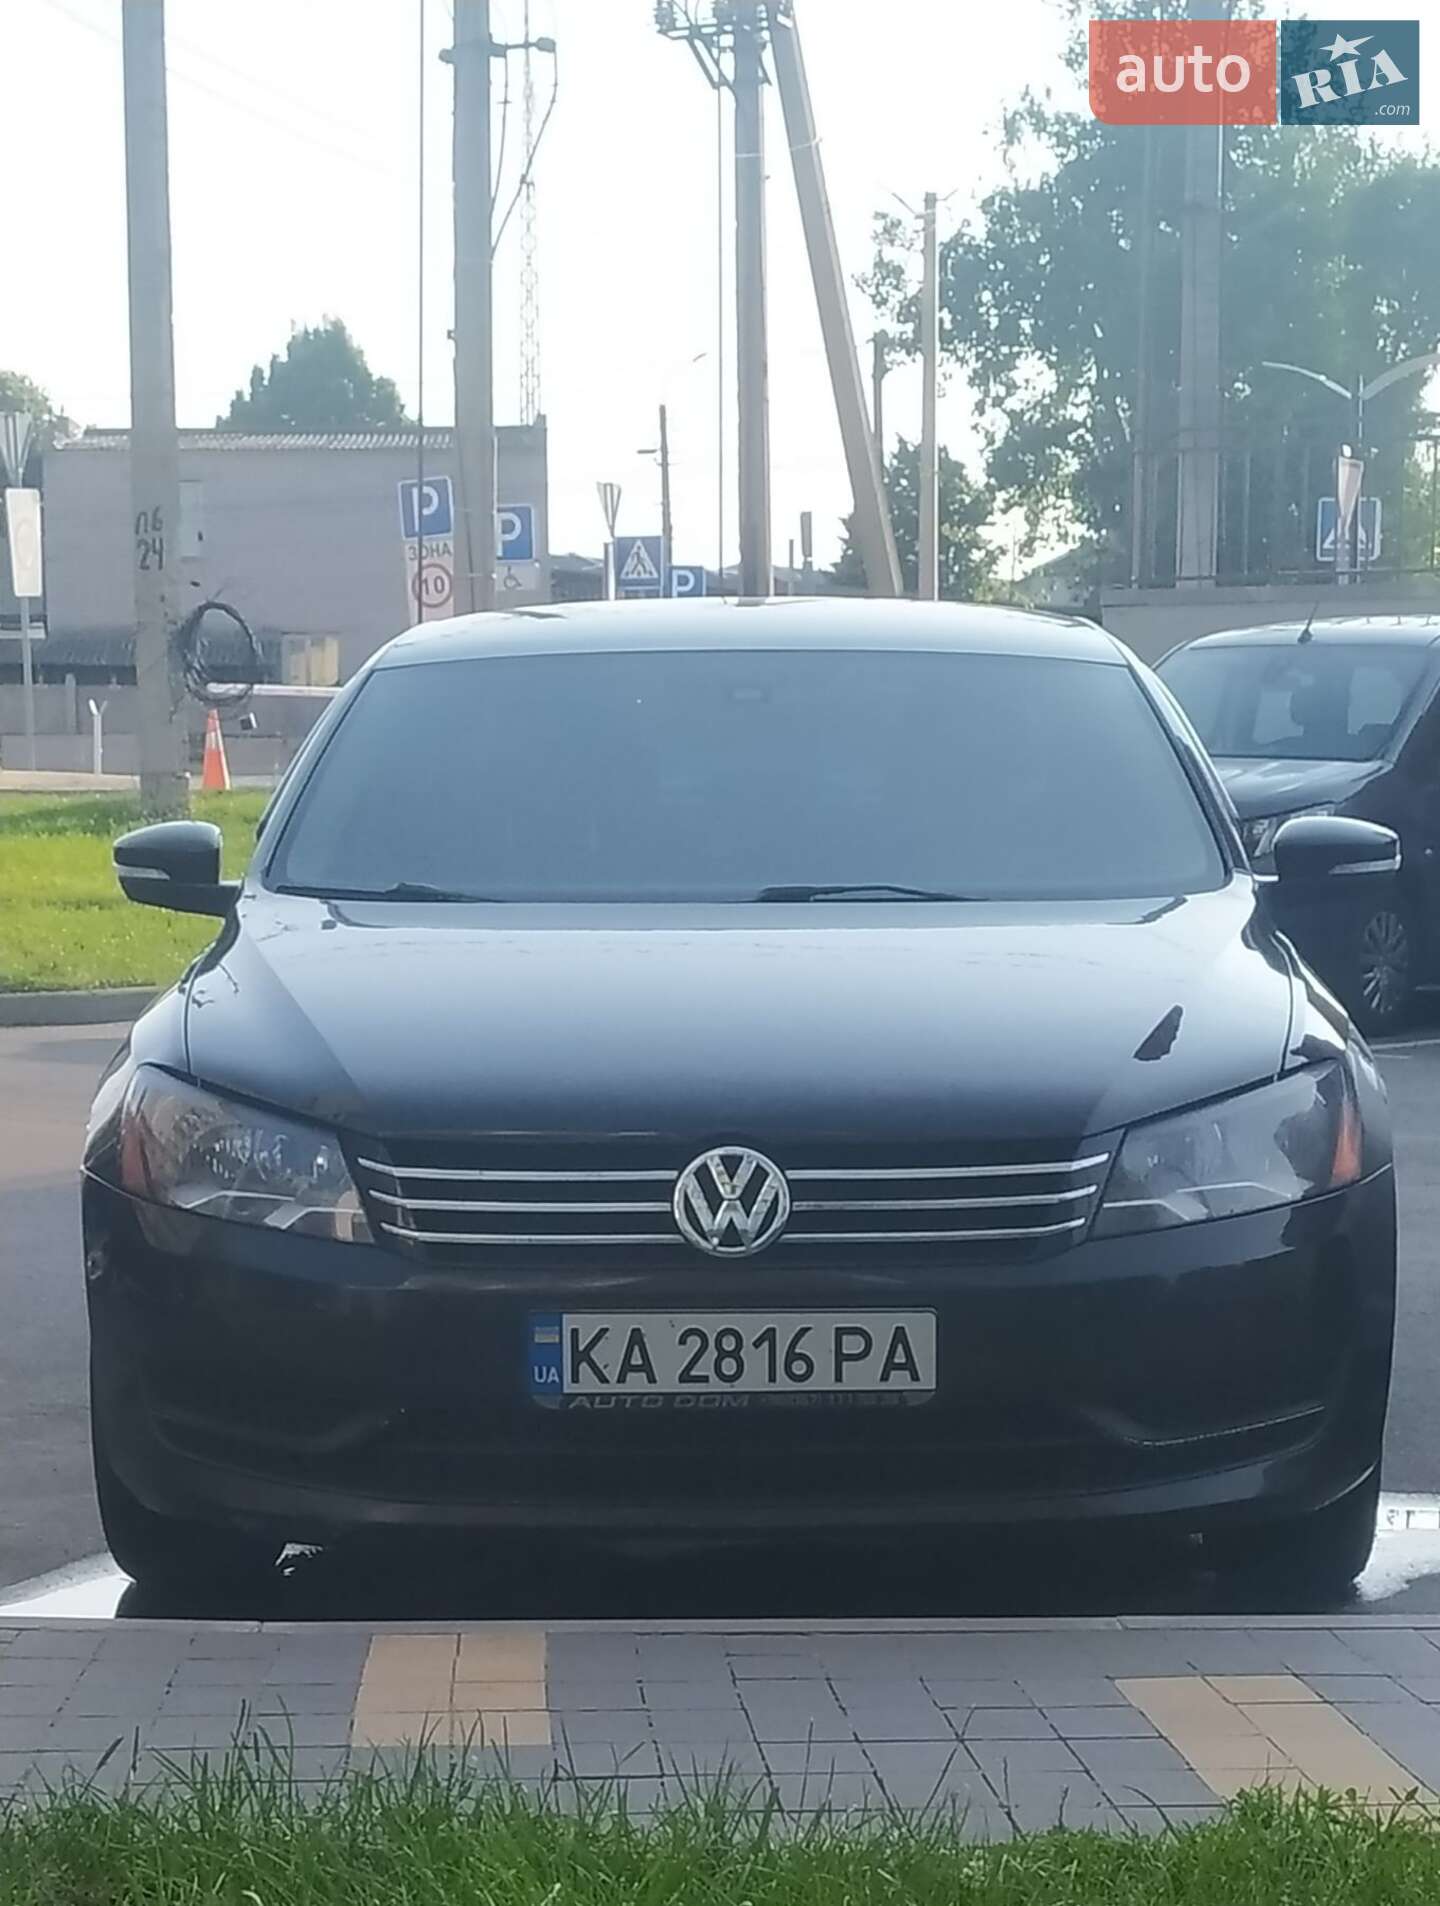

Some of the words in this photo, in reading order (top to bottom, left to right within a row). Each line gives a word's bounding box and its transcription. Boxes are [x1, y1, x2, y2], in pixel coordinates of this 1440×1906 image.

[412, 485, 439, 534] P
[496, 511, 522, 558] P
[136, 537, 165, 571] 24
[420, 574, 446, 597] 10
[570, 1326, 658, 1385] KA
[676, 1326, 815, 1384] 2816
[833, 1325, 922, 1383] PA
[533, 1366, 560, 1384] UA
[568, 1394, 664, 1409] AUTO
